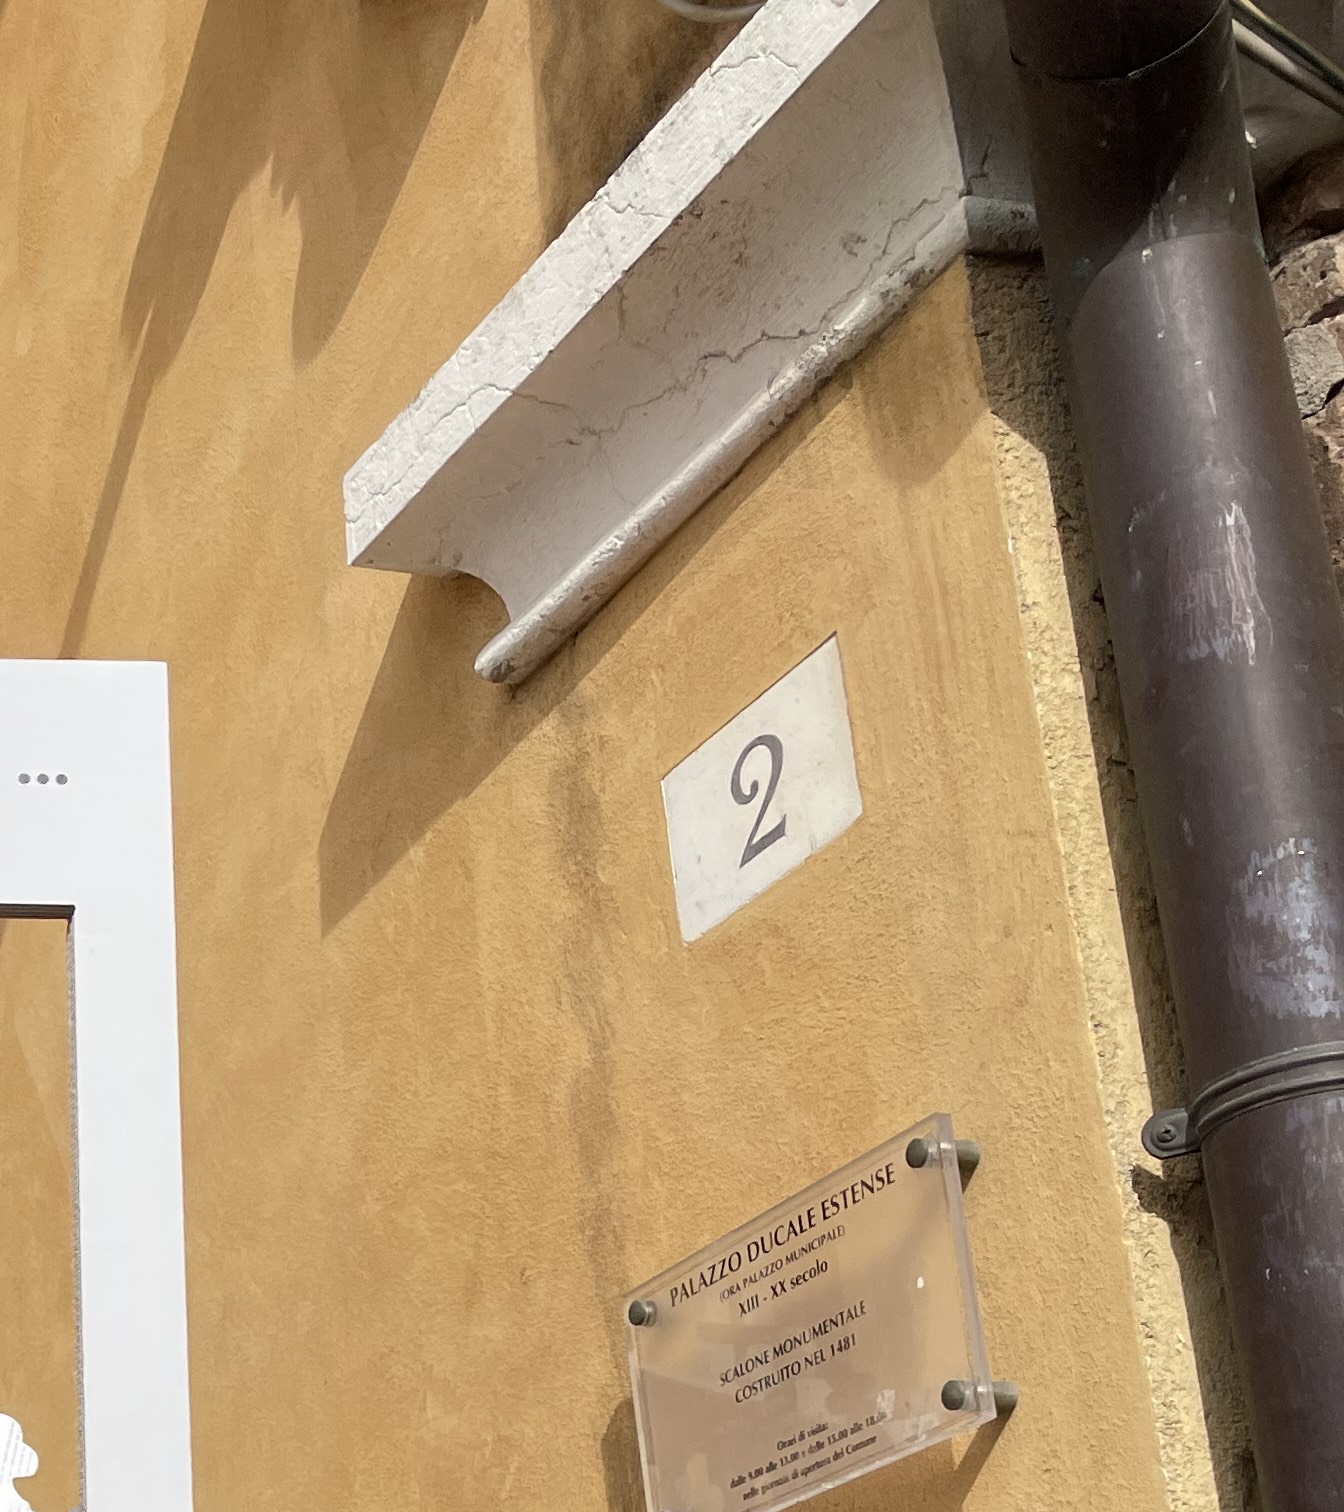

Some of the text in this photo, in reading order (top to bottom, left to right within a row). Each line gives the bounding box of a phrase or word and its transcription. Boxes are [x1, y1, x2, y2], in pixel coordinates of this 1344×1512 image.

[730, 733, 787, 869] 2
[669, 1162, 896, 1307] PALAZZO DUCALE ESTENSE
[719, 1224, 846, 1303] (ORA PALAZZO MUNICIPALE)
[738, 1293, 759, 1317] XIII
[770, 1279, 787, 1301] XX
[790, 1259, 828, 1289] secolo
[719, 1300, 867, 1386] SCALONE MONUMENTALE
[735, 1333, 856, 1403] COSTRUITO NEL 1481
